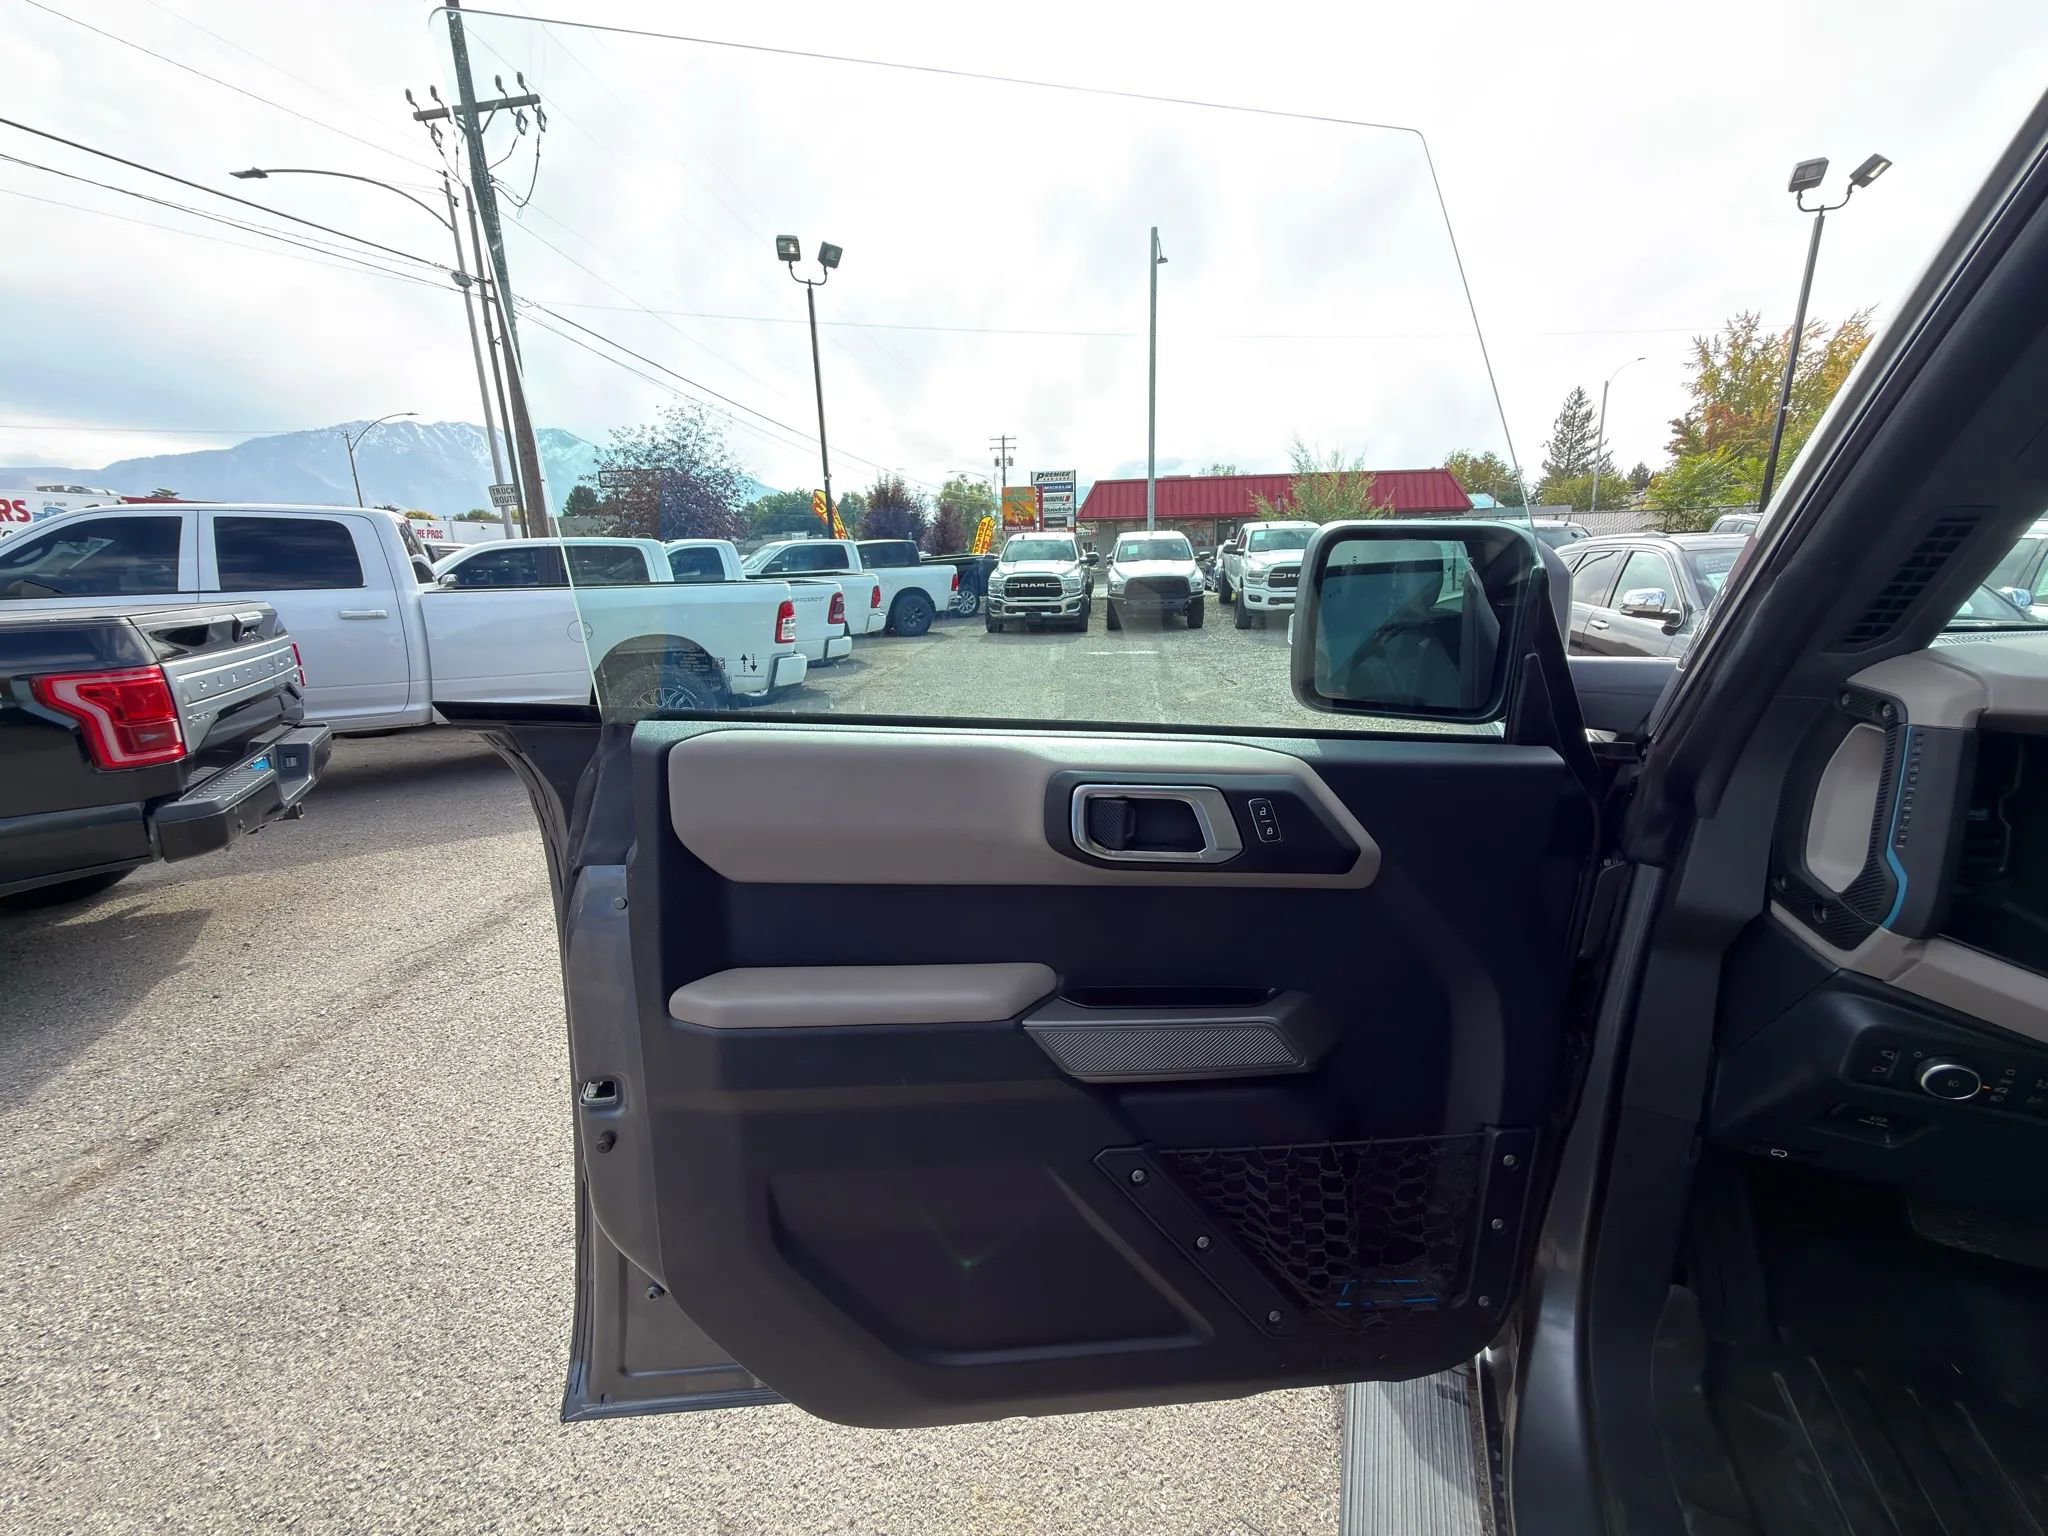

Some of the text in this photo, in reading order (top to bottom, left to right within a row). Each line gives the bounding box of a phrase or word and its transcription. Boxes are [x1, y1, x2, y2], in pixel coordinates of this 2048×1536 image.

[1036, 471, 1071, 481] PREMIER
[492, 487, 515, 495] TRUCK
[495, 495, 517, 504] ROUTE
[427, 530, 443, 539] PROS
